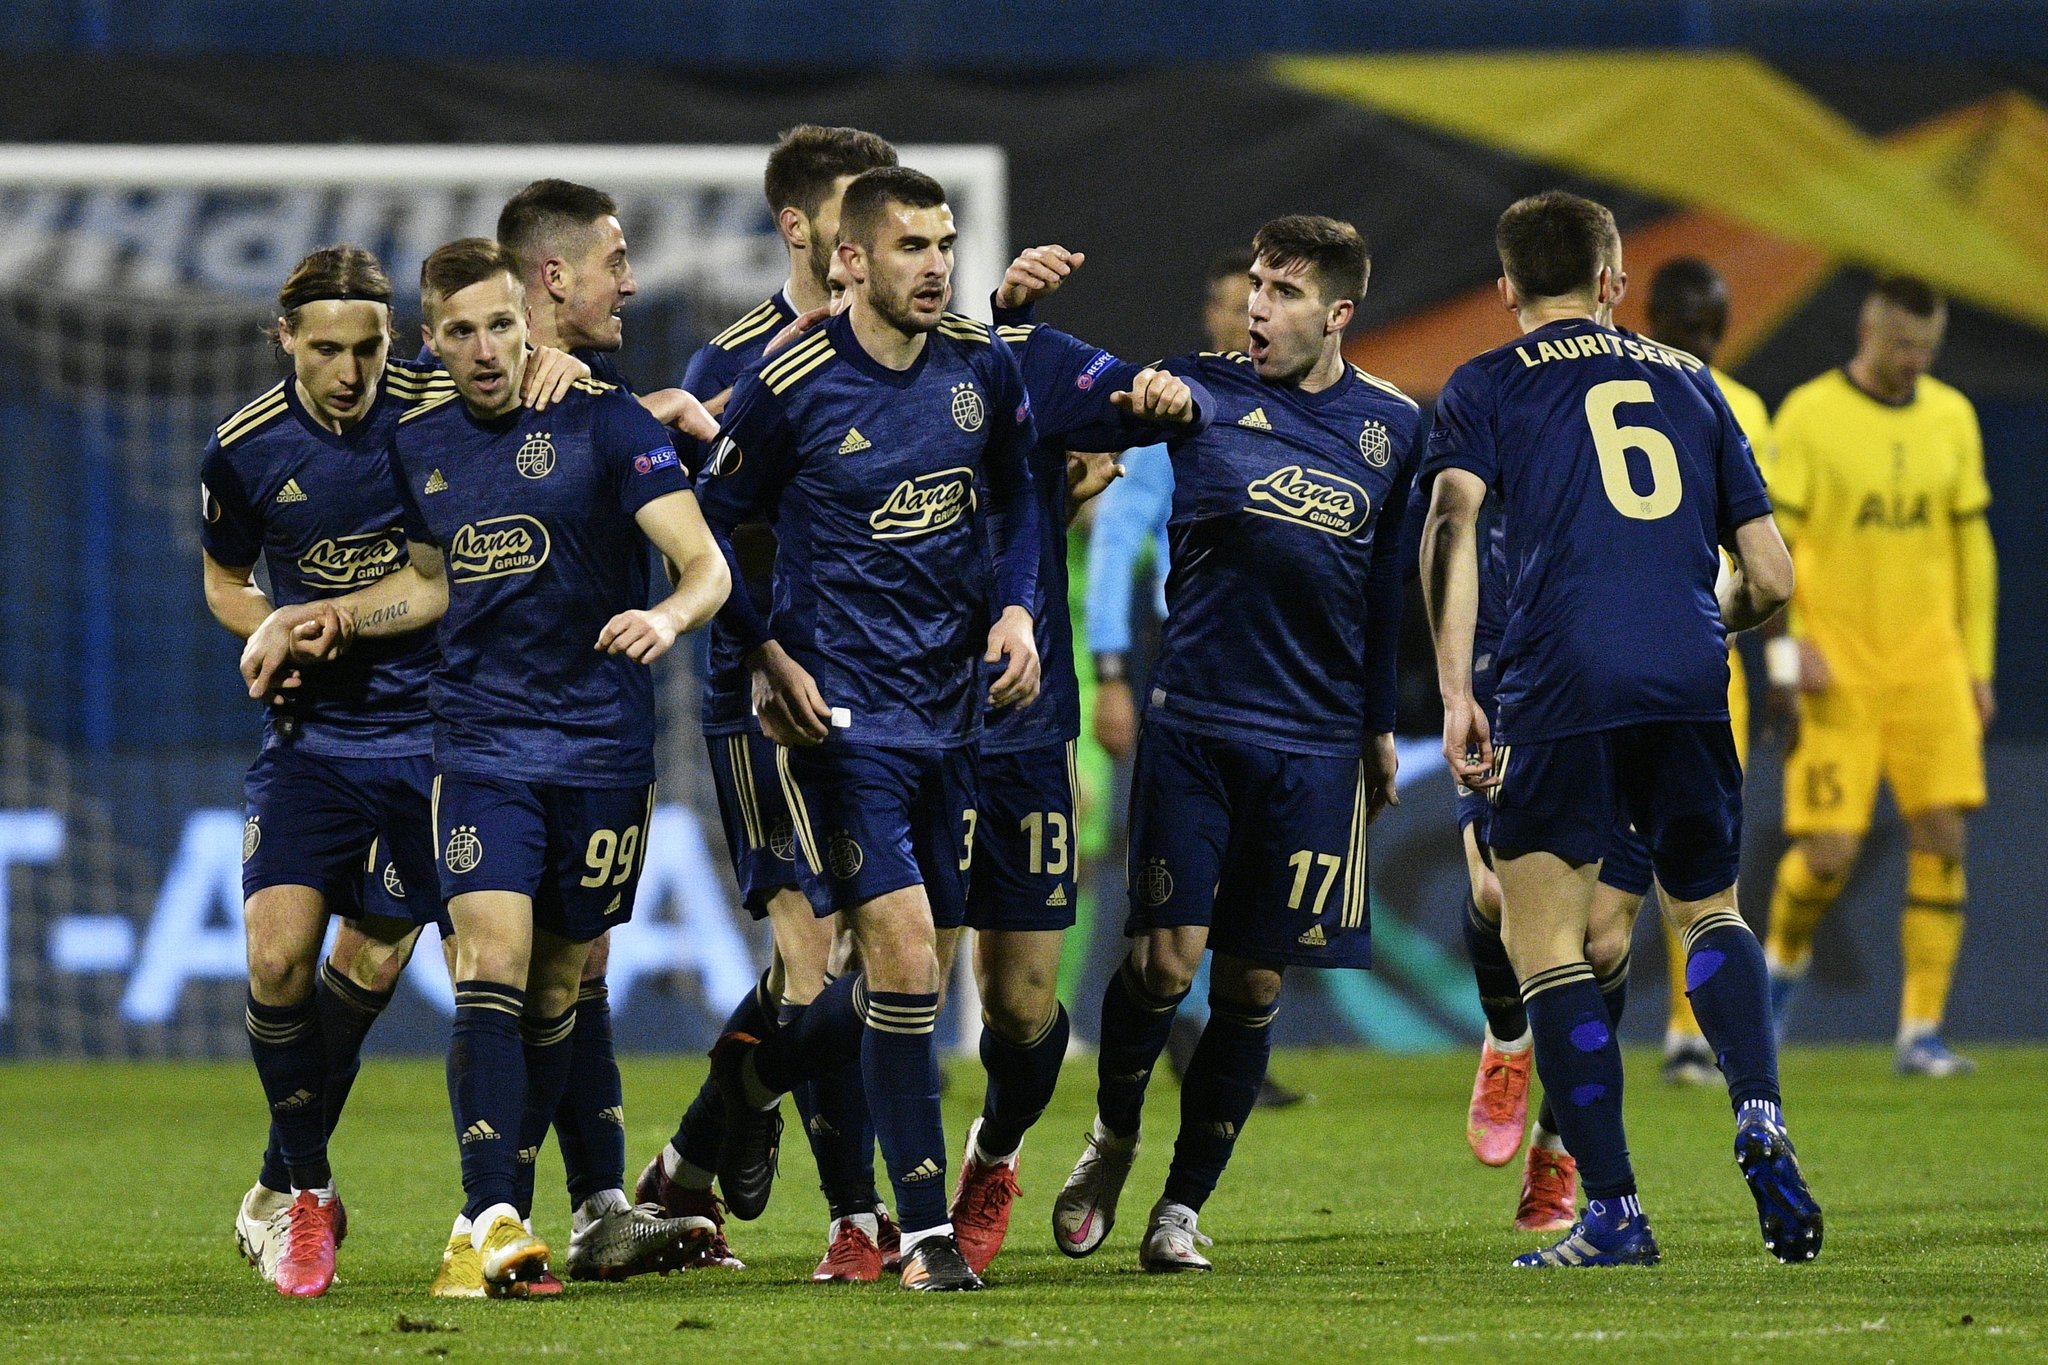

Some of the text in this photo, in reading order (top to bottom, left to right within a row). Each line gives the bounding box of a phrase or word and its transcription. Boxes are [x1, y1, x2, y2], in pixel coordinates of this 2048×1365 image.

[1514, 332, 1683, 371] LAURITSEN
[1237, 418, 1273, 431] adidas
[837, 438, 872, 455] adidas
[1585, 379, 1683, 520] 6
[276, 492, 308, 503] adidas
[1308, 510, 1352, 532] GRUPA
[494, 554, 536, 570] GRUPA
[356, 563, 401, 579] GRUA
[1020, 811, 1069, 875] 13
[580, 825, 639, 888] 99
[1287, 849, 1342, 915] 17
[461, 1132, 501, 1145] adidas
[901, 1167, 944, 1183] adidas
